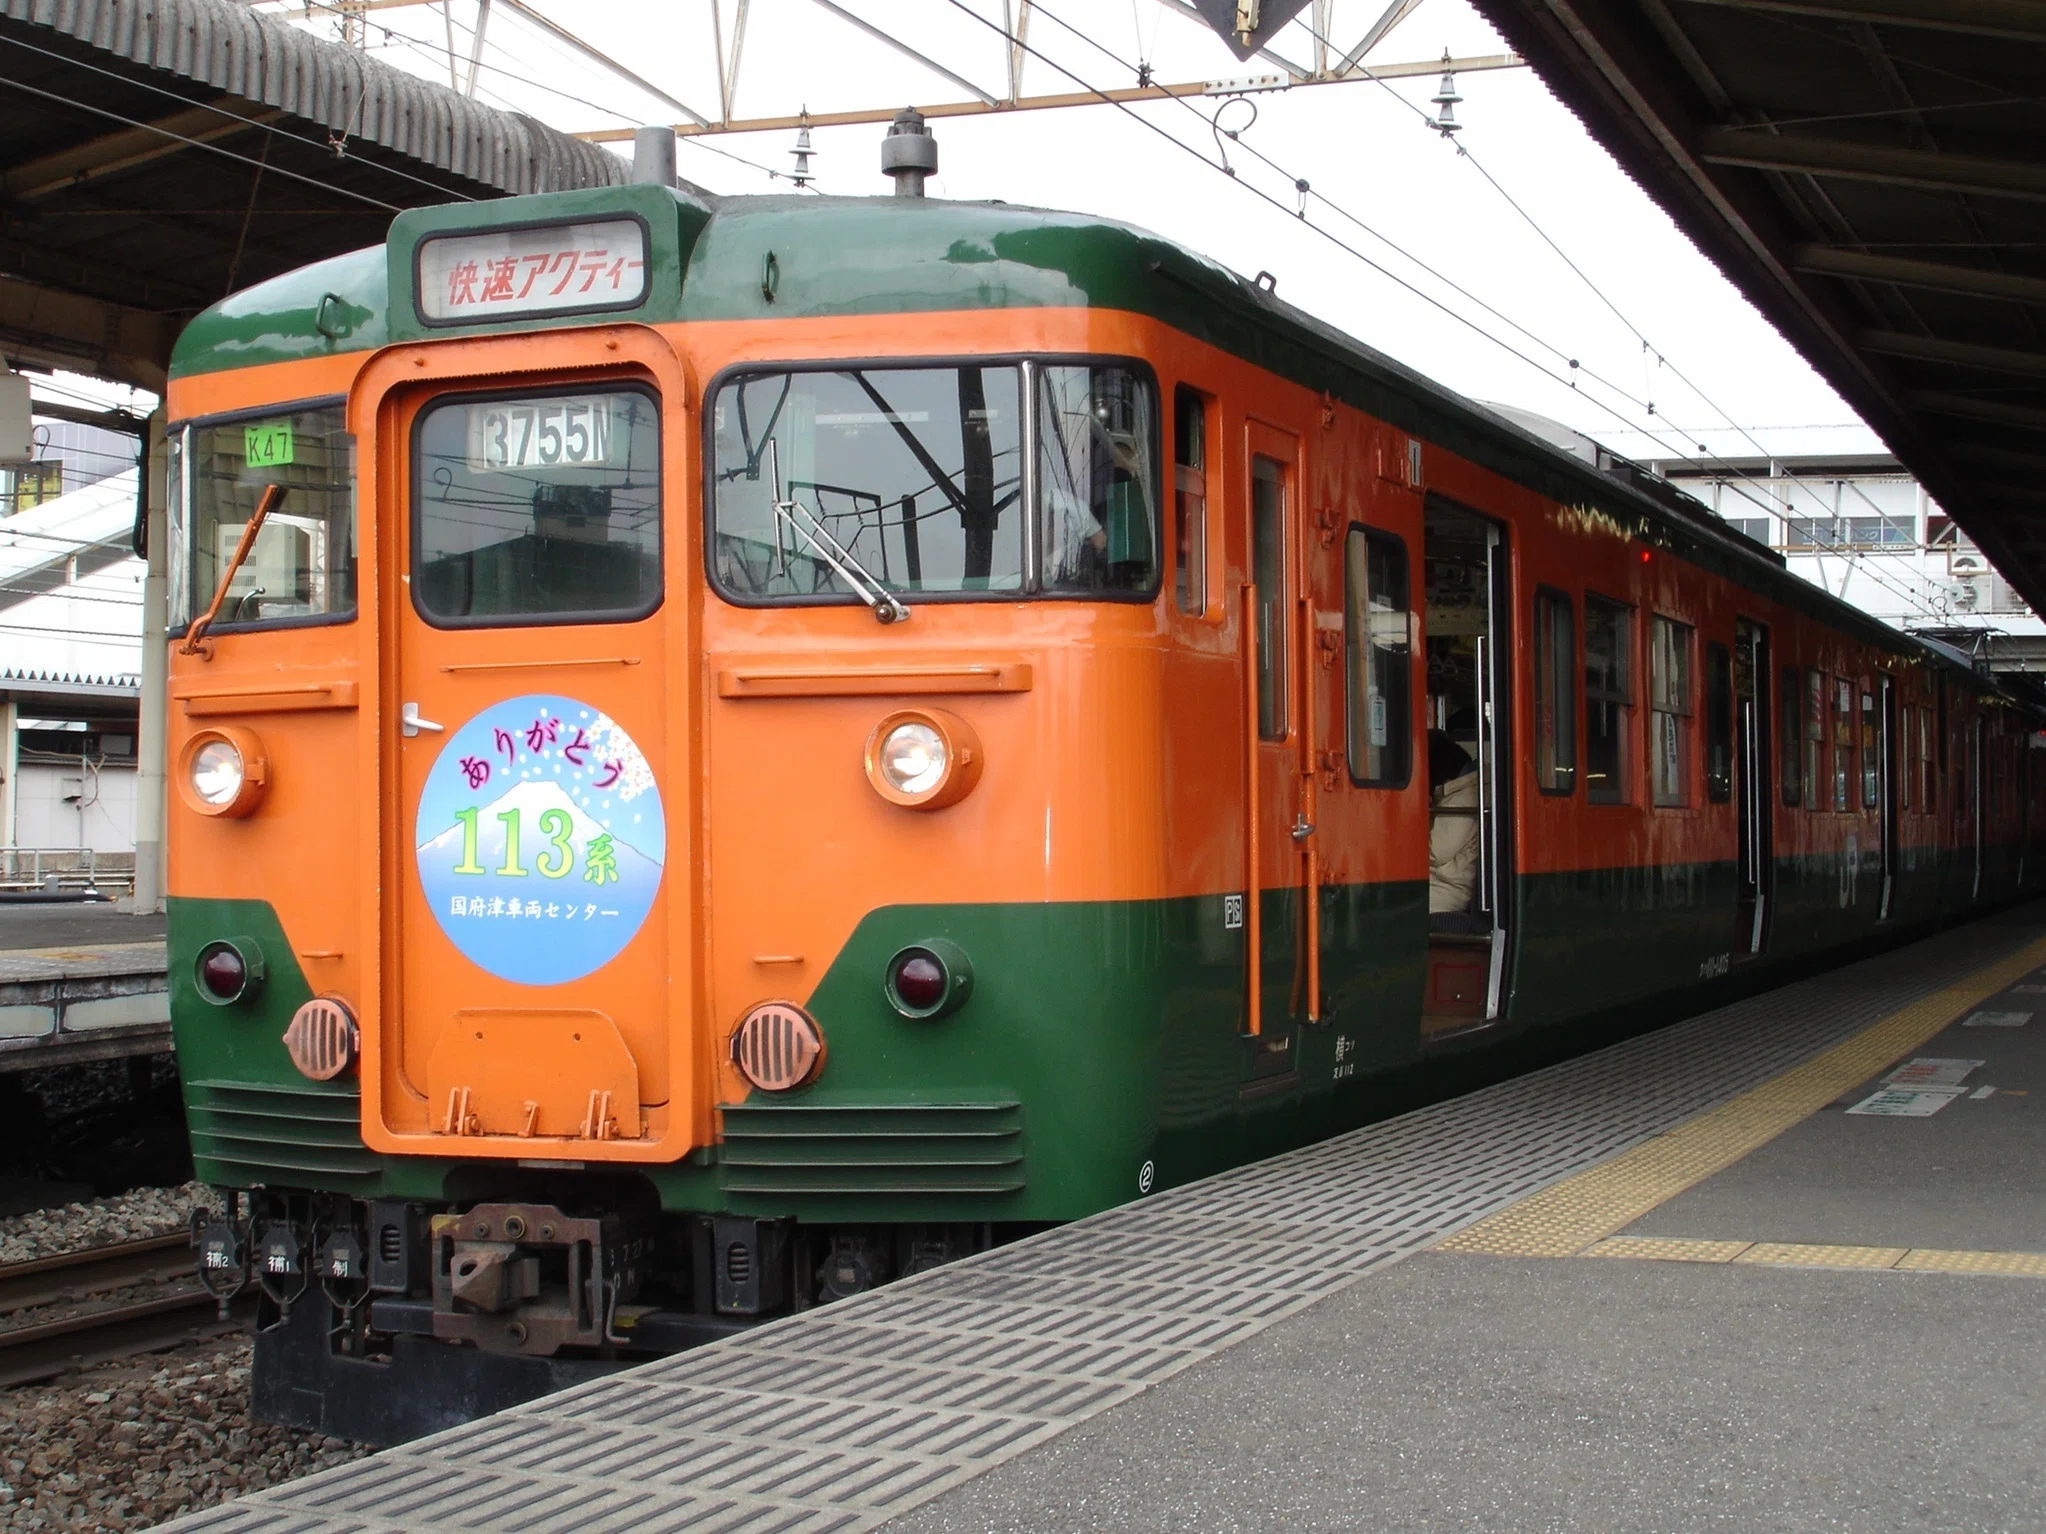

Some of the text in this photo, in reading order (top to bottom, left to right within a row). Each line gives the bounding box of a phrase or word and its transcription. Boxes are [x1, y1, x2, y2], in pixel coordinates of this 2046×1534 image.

[248, 432, 287, 462] K47
[459, 718, 624, 791] ありがとう
[453, 806, 620, 887] 113系
[450, 896, 620, 921] 国府津車両センター
